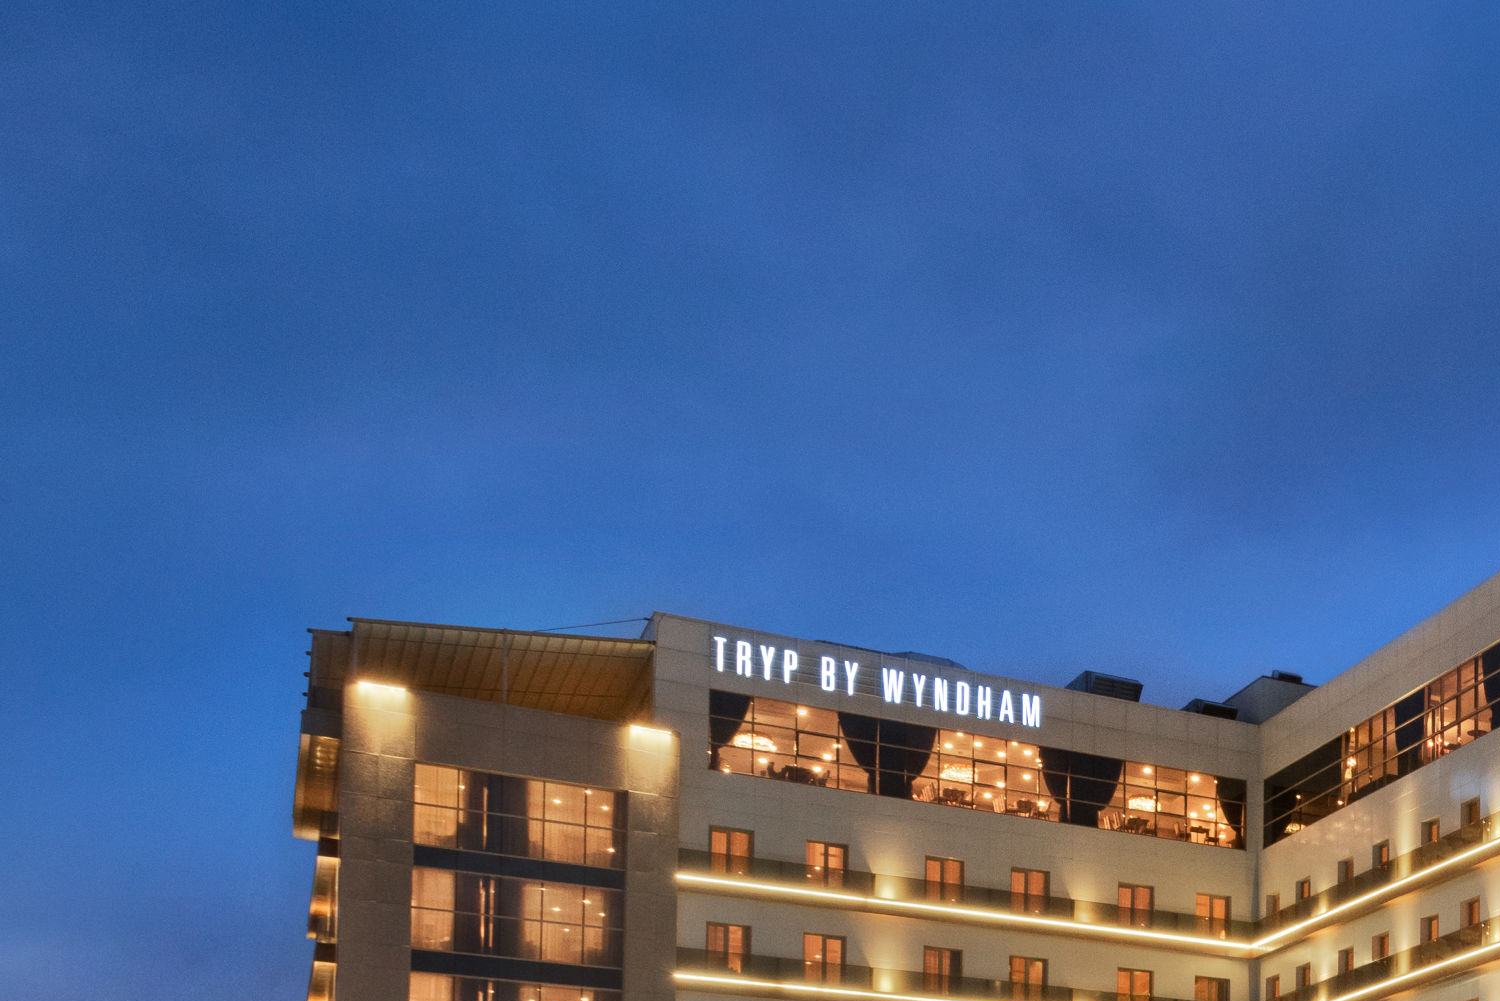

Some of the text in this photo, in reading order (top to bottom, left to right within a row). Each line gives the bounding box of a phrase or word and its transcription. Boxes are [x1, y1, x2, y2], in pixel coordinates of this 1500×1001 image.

[713, 636, 1041, 728] TRYP BY WYNDHAM
